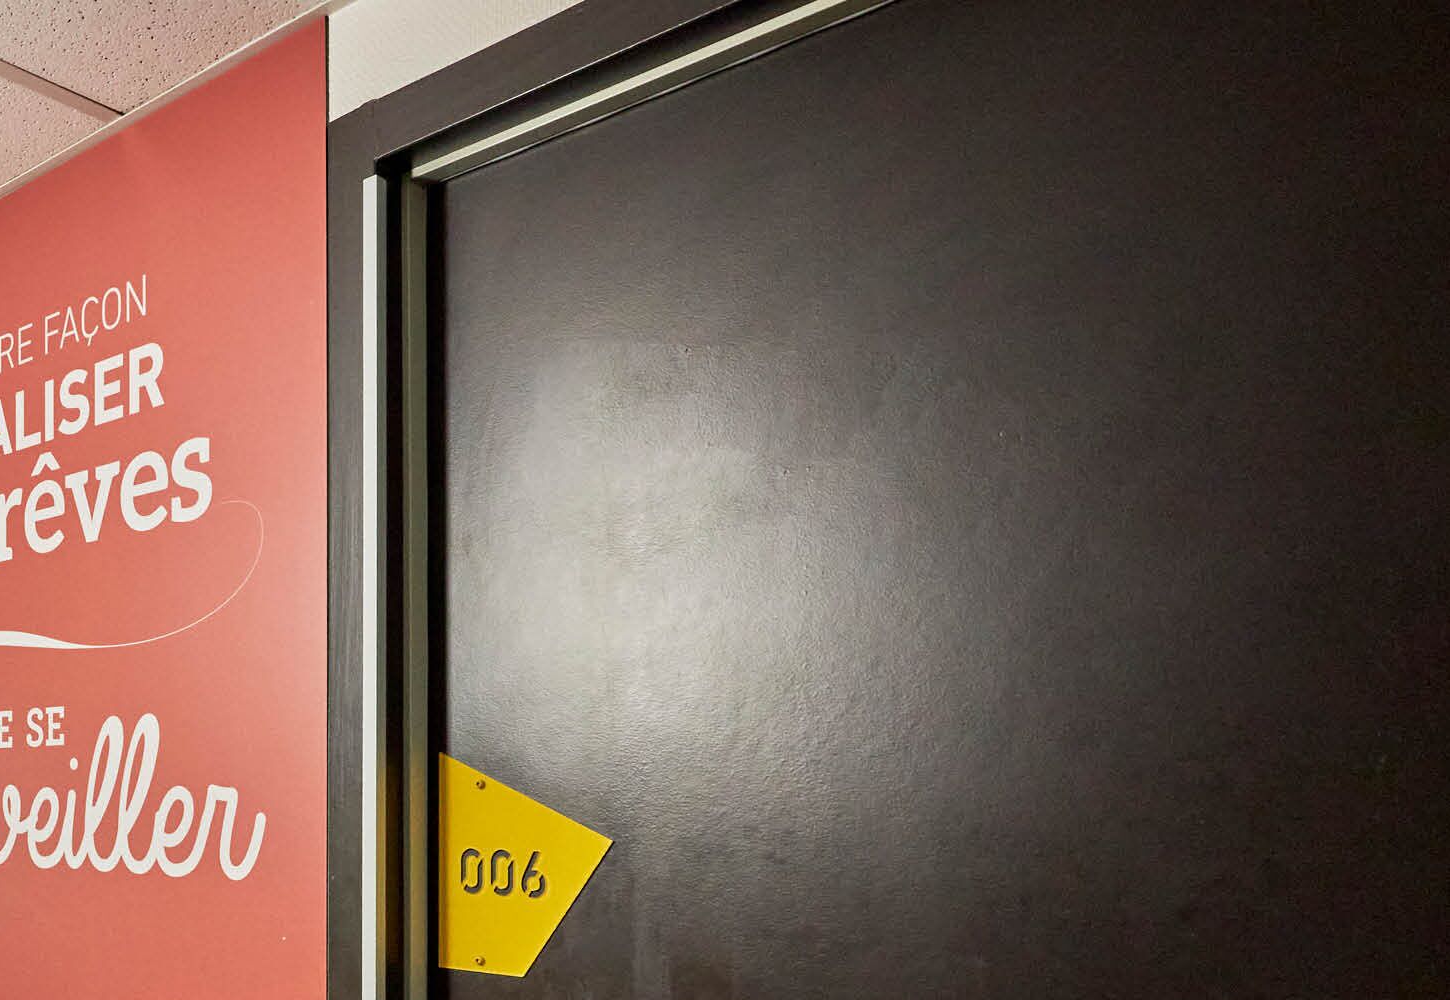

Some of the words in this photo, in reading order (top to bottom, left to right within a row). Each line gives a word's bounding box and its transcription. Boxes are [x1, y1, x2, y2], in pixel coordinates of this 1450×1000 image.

[45, 273, 147, 355] FAÇON
[25, 705, 66, 748] SE
[460, 848, 546, 898] 006
